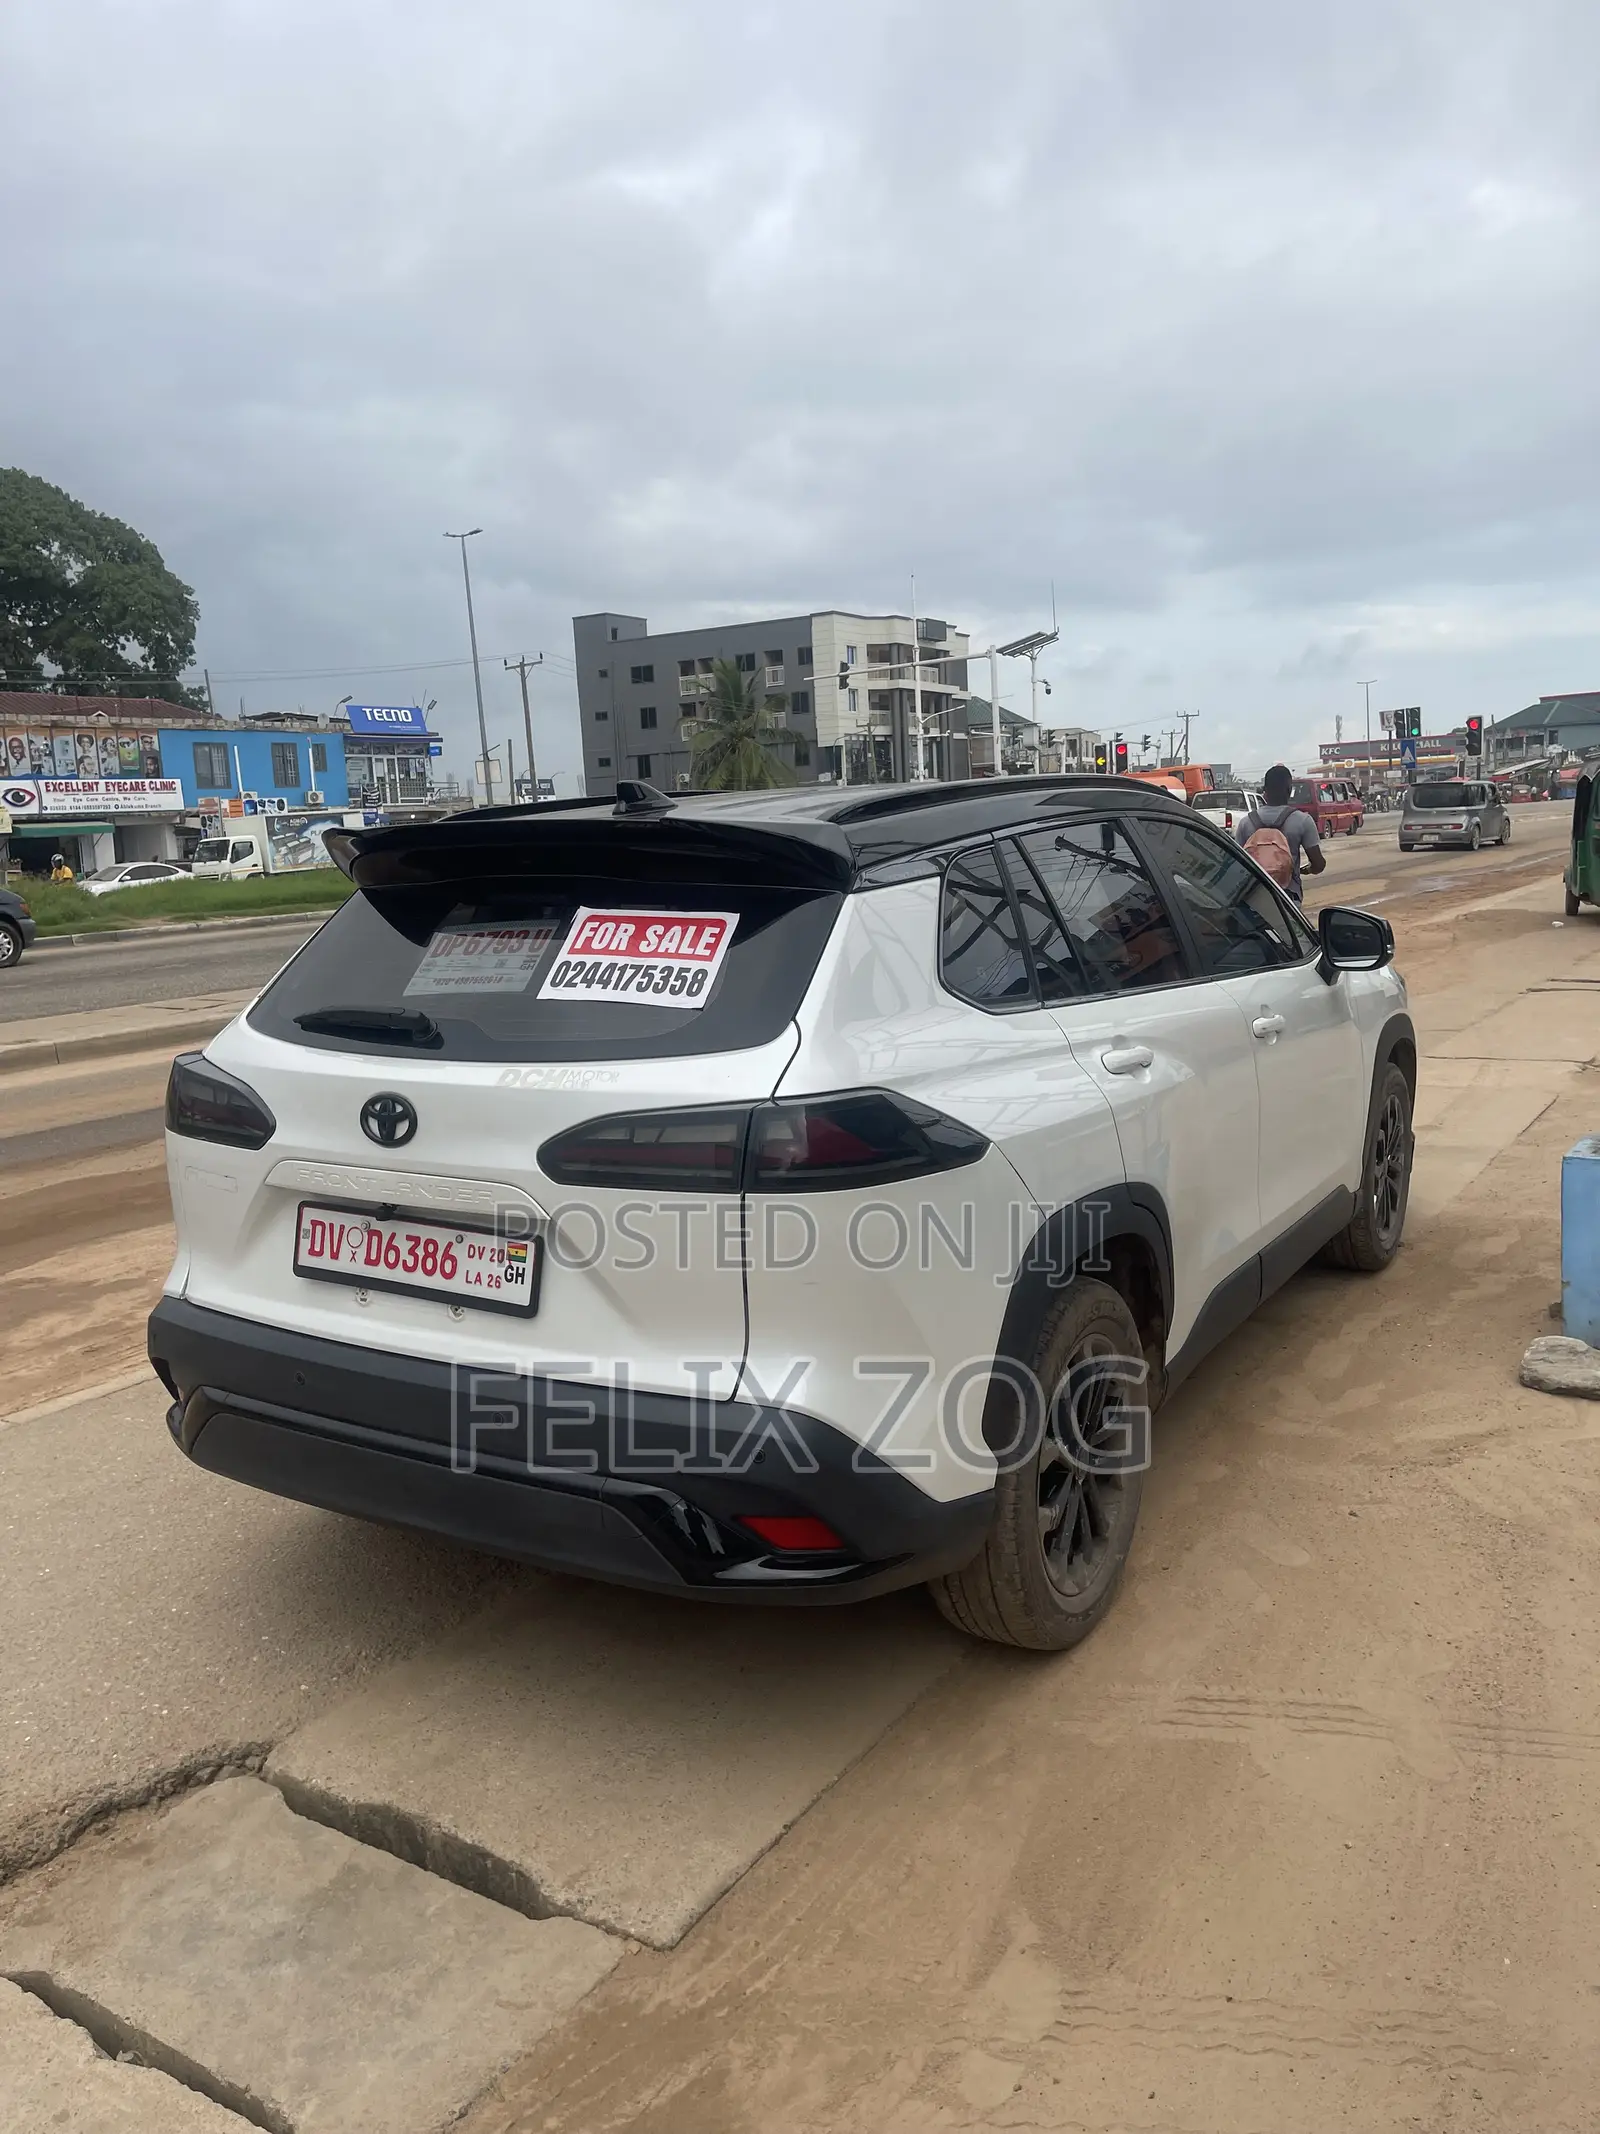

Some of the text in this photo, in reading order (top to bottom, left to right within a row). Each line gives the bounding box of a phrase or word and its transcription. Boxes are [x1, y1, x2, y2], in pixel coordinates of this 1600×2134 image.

[362, 708, 412, 722] TECNO
[1321, 747, 1341, 756] KFC
[44, 780, 176, 792] EXCELLENT EYECARE CLINIC
[574, 921, 721, 956] FOR SALE
[520, 963, 535, 971] GH
[550, 960, 709, 998] 0244175358
[308, 1219, 458, 1280] DV D6386
[467, 1244, 486, 1260] DV
[465, 1270, 502, 1289] LA 26
[504, 1264, 525, 1285] GH
